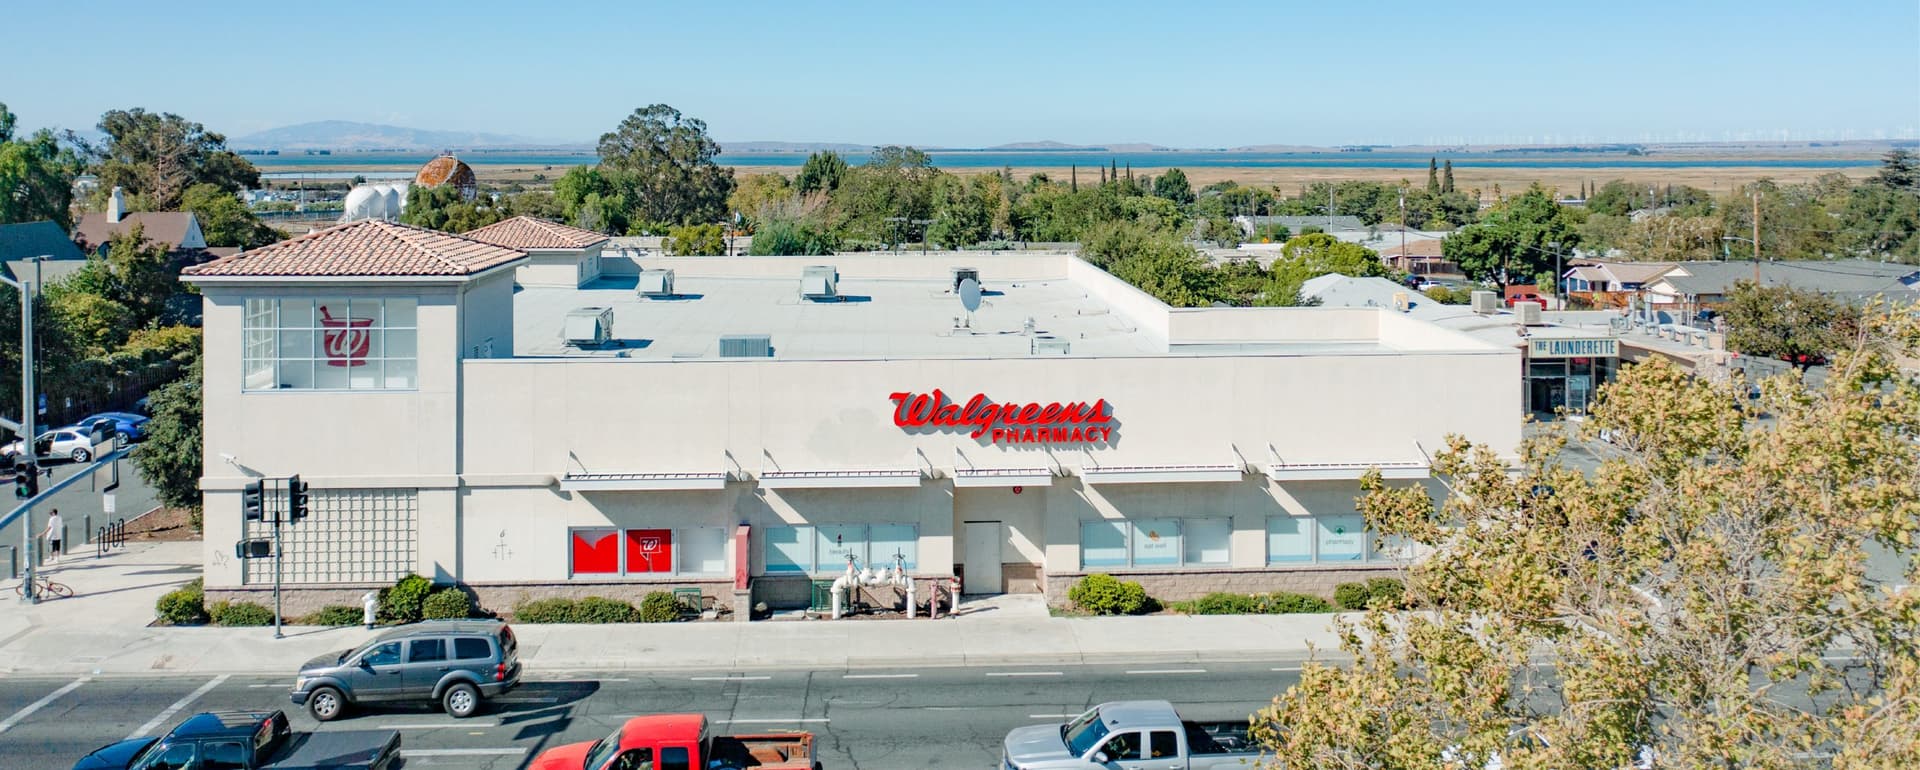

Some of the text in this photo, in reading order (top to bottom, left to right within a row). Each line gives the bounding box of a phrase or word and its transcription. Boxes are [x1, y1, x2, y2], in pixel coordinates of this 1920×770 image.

[1535, 340, 1615, 354] THE LAUNDERETTE
[889, 388, 1113, 439] Walgreens
[992, 427, 1112, 444] PHARMACY
